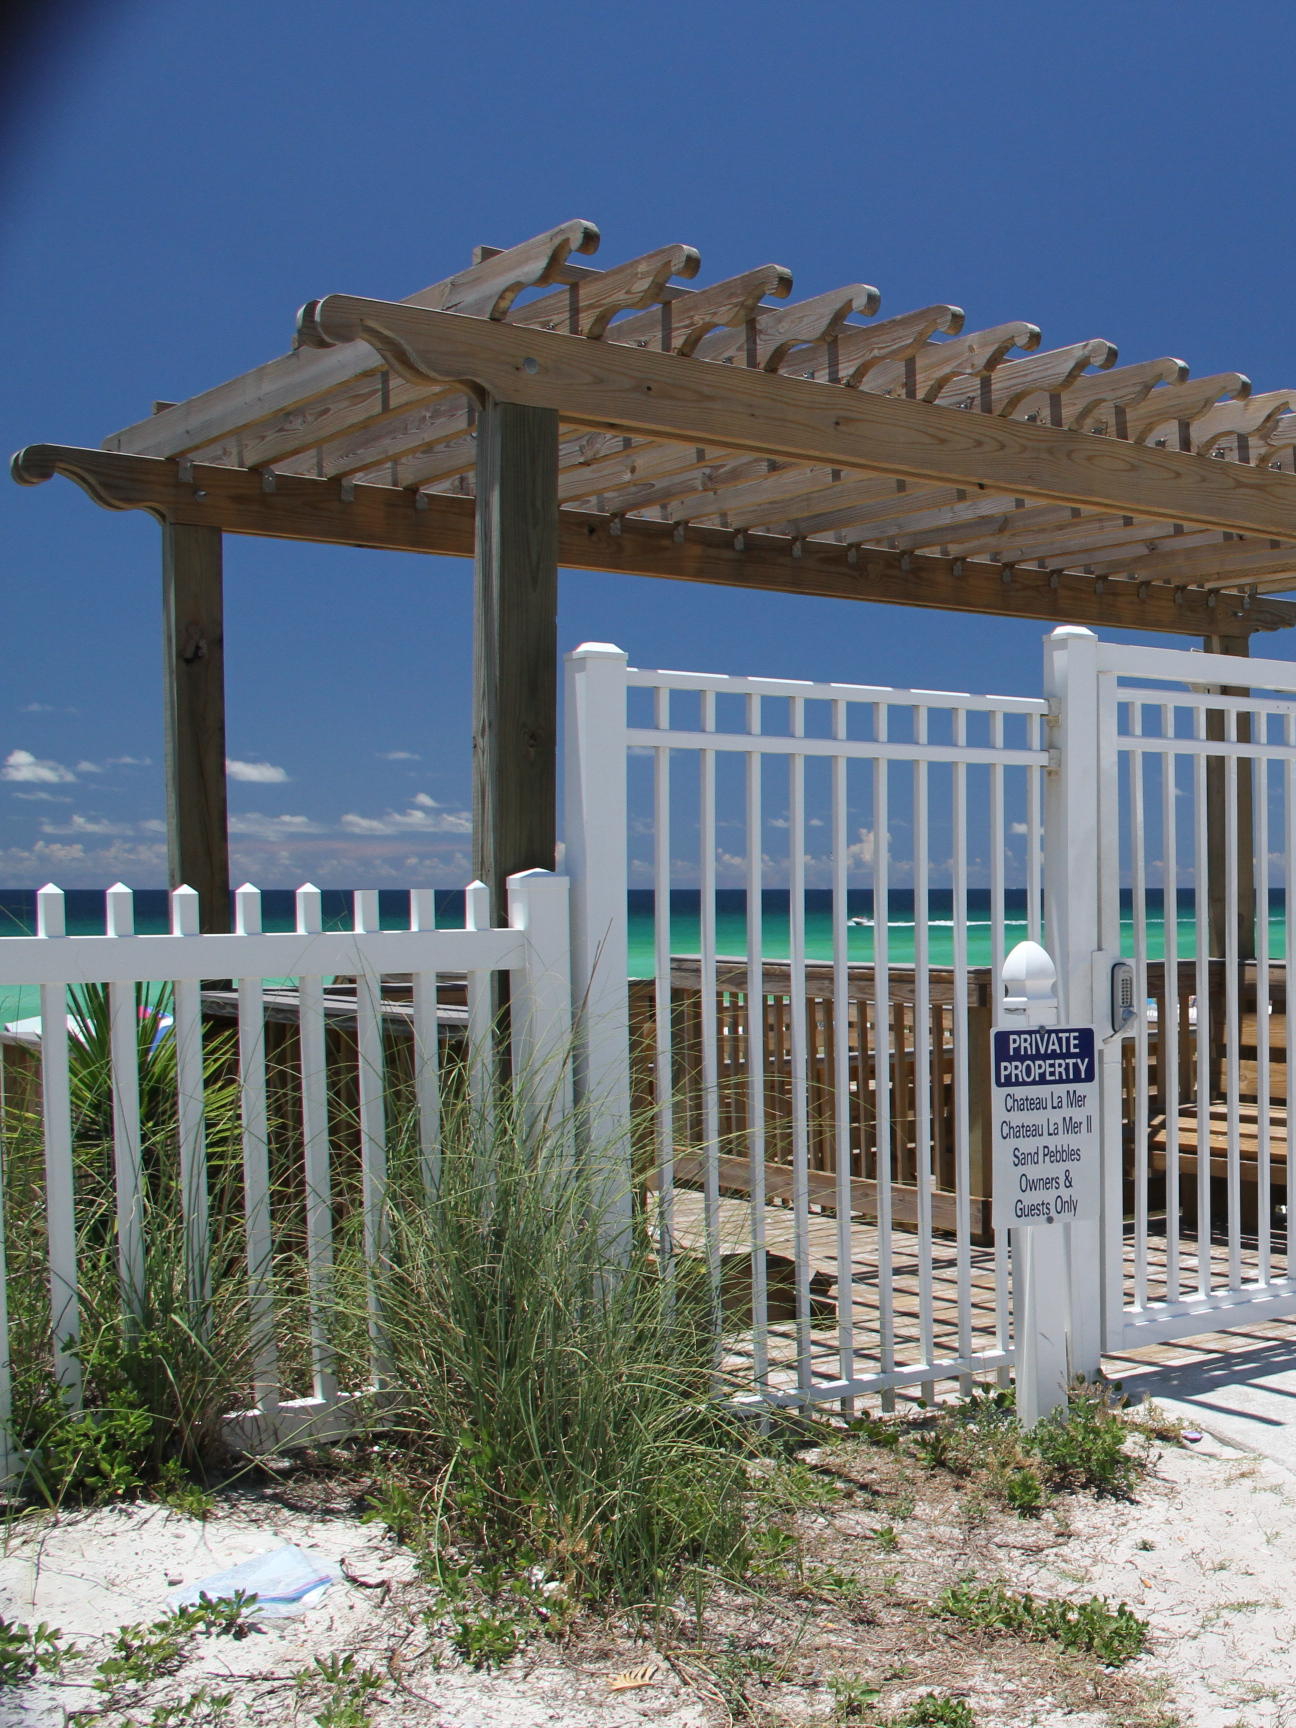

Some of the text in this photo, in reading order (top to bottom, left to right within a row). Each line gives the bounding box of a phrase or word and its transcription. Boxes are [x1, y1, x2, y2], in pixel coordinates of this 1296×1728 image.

[1009, 1032, 1080, 1056] PRIVATE
[1000, 1058, 1089, 1083] PROPERTY
[1004, 1090, 1087, 1113] Chateau La Mer
[1000, 1115, 1092, 1140] Chateau La Mer II
[1012, 1144, 1081, 1167] Sand Pebbles
[1019, 1169, 1073, 1193] Owners &
[1014, 1195, 1078, 1219] Guests Only
